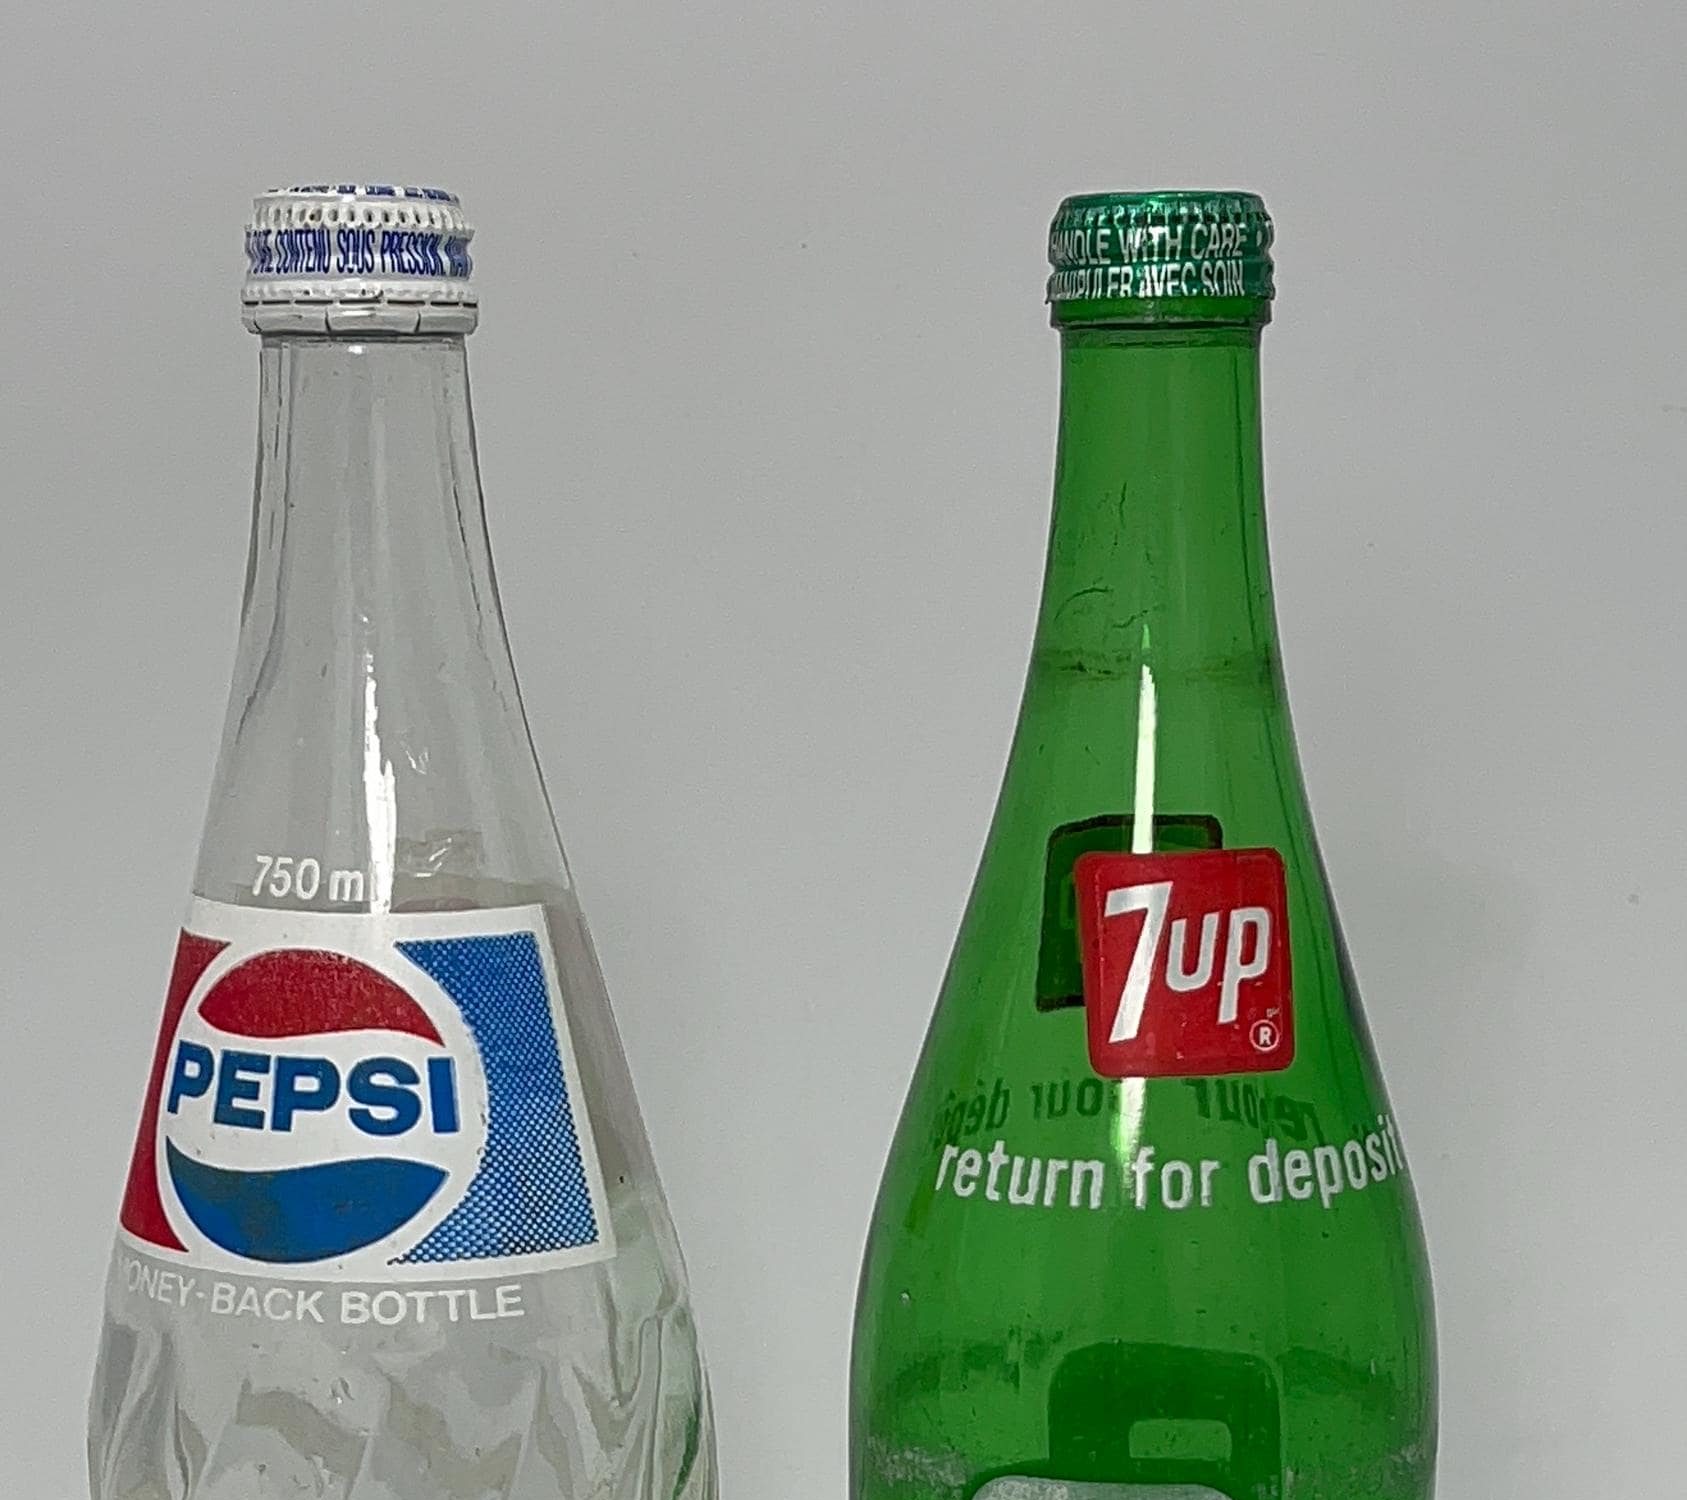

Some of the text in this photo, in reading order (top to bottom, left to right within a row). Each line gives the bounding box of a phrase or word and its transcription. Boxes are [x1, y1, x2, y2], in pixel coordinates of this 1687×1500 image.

[336, 228, 376, 275] SOUS
[1050, 227, 1111, 265] ANDLE
[1118, 224, 1183, 262] WITH
[1191, 222, 1247, 260] CARE
[1138, 261, 1198, 298] AVEC
[1201, 259, 1246, 297] SOIN
[252, 854, 320, 900] 750
[167, 1039, 460, 1136] PEPSI
[935, 1113, 1403, 1210] return for deposit
[340, 1284, 525, 1325] BOTTLE
